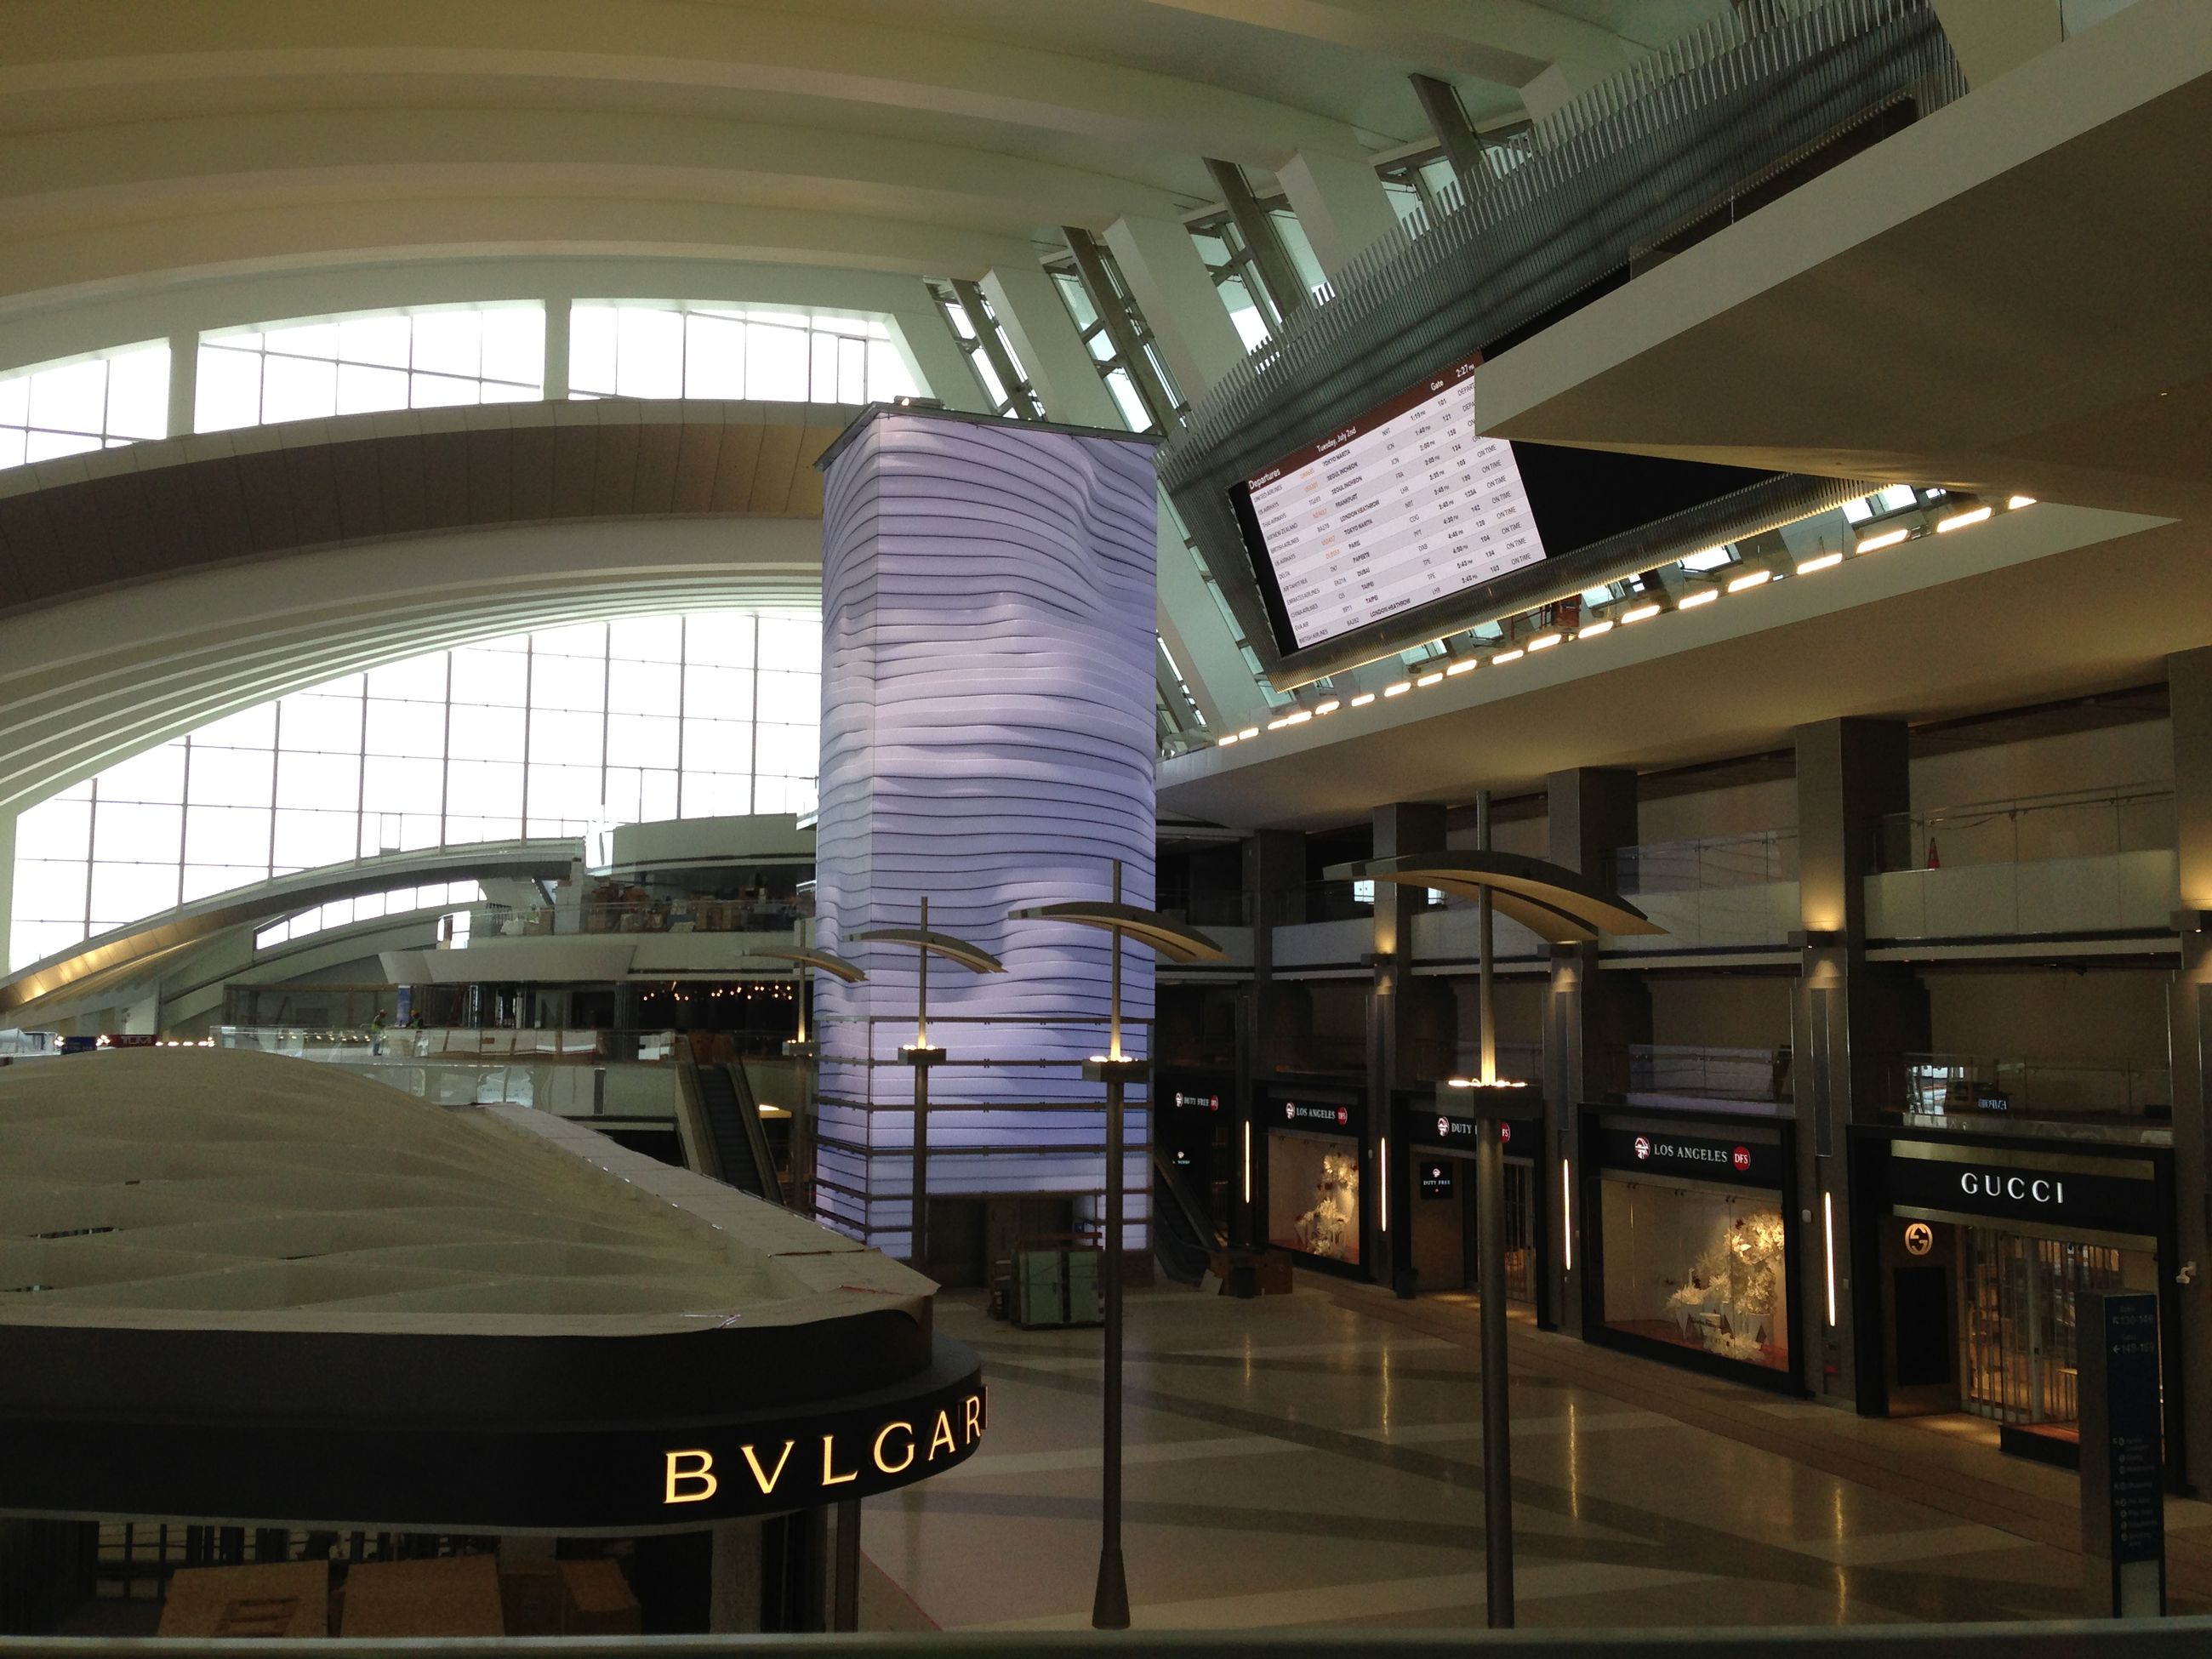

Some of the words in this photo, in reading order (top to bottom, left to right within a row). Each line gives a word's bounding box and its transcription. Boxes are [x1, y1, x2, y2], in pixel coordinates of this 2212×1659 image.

[1249, 468, 1280, 490] Departures
[1317, 438, 1337, 453] Tuesday,
[1337, 432, 1347, 444] July
[1346, 426, 1357, 437] 2nd
[1430, 379, 1444, 391] Gate
[1456, 364, 1469, 378] 2:27
[1322, 456, 1336, 467] TOKYO
[1336, 448, 1350, 460] NARITA
[1438, 398, 1446, 407] 101
[1457, 383, 1475, 396] DEPART
[1326, 470, 1339, 481] SEOUL
[1339, 461, 1358, 475] INCHEON
[1462, 401, 1476, 412] DEPA
[1280, 522, 1297, 534] ZEALAND
[1335, 493, 1358, 508] FRANKFURT
[1331, 484, 1343, 494] SEOUL
[1343, 475, 1362, 488] INCHEON
[1339, 510, 1357, 522] LONDON
[1485, 444, 1497, 454] TIME
[1343, 525, 1358, 535] TOKYO
[1490, 459, 1502, 470] TIME
[1499, 491, 1512, 500] TIME
[1278, 571, 1290, 579] DELTA
[1348, 540, 1360, 549] PARIS
[1409, 514, 1419, 522] CDG
[1494, 476, 1507, 485] TIME
[1356, 567, 1370, 577] DUBAI
[1504, 506, 1517, 516] TIME
[1360, 581, 1374, 590] TAIPEI
[1509, 522, 1521, 532] TIME
[1365, 595, 1378, 604] TAIPEI
[1514, 538, 1526, 547] TIME
[1369, 607, 1388, 618] LONDON
[1387, 598, 1411, 611] HEATHROW
[1519, 553, 1531, 562] TIME
[122, 1035, 151, 1045] TUMI
[1183, 1097, 1196, 1105] DUTY
[1197, 1097, 1210, 1106] FREE
[1297, 1107, 1309, 1118] LOS
[1310, 1109, 1335, 1121] ANGELES
[1451, 1122, 1472, 1134] DUTY
[1654, 1143, 1673, 1157] LOS
[1677, 1146, 1728, 1163] ANGELES
[1734, 1153, 1749, 1165] DFS
[1961, 1172, 2063, 1204] GUCCI
[663, 1390, 985, 1504] BVLGAR
